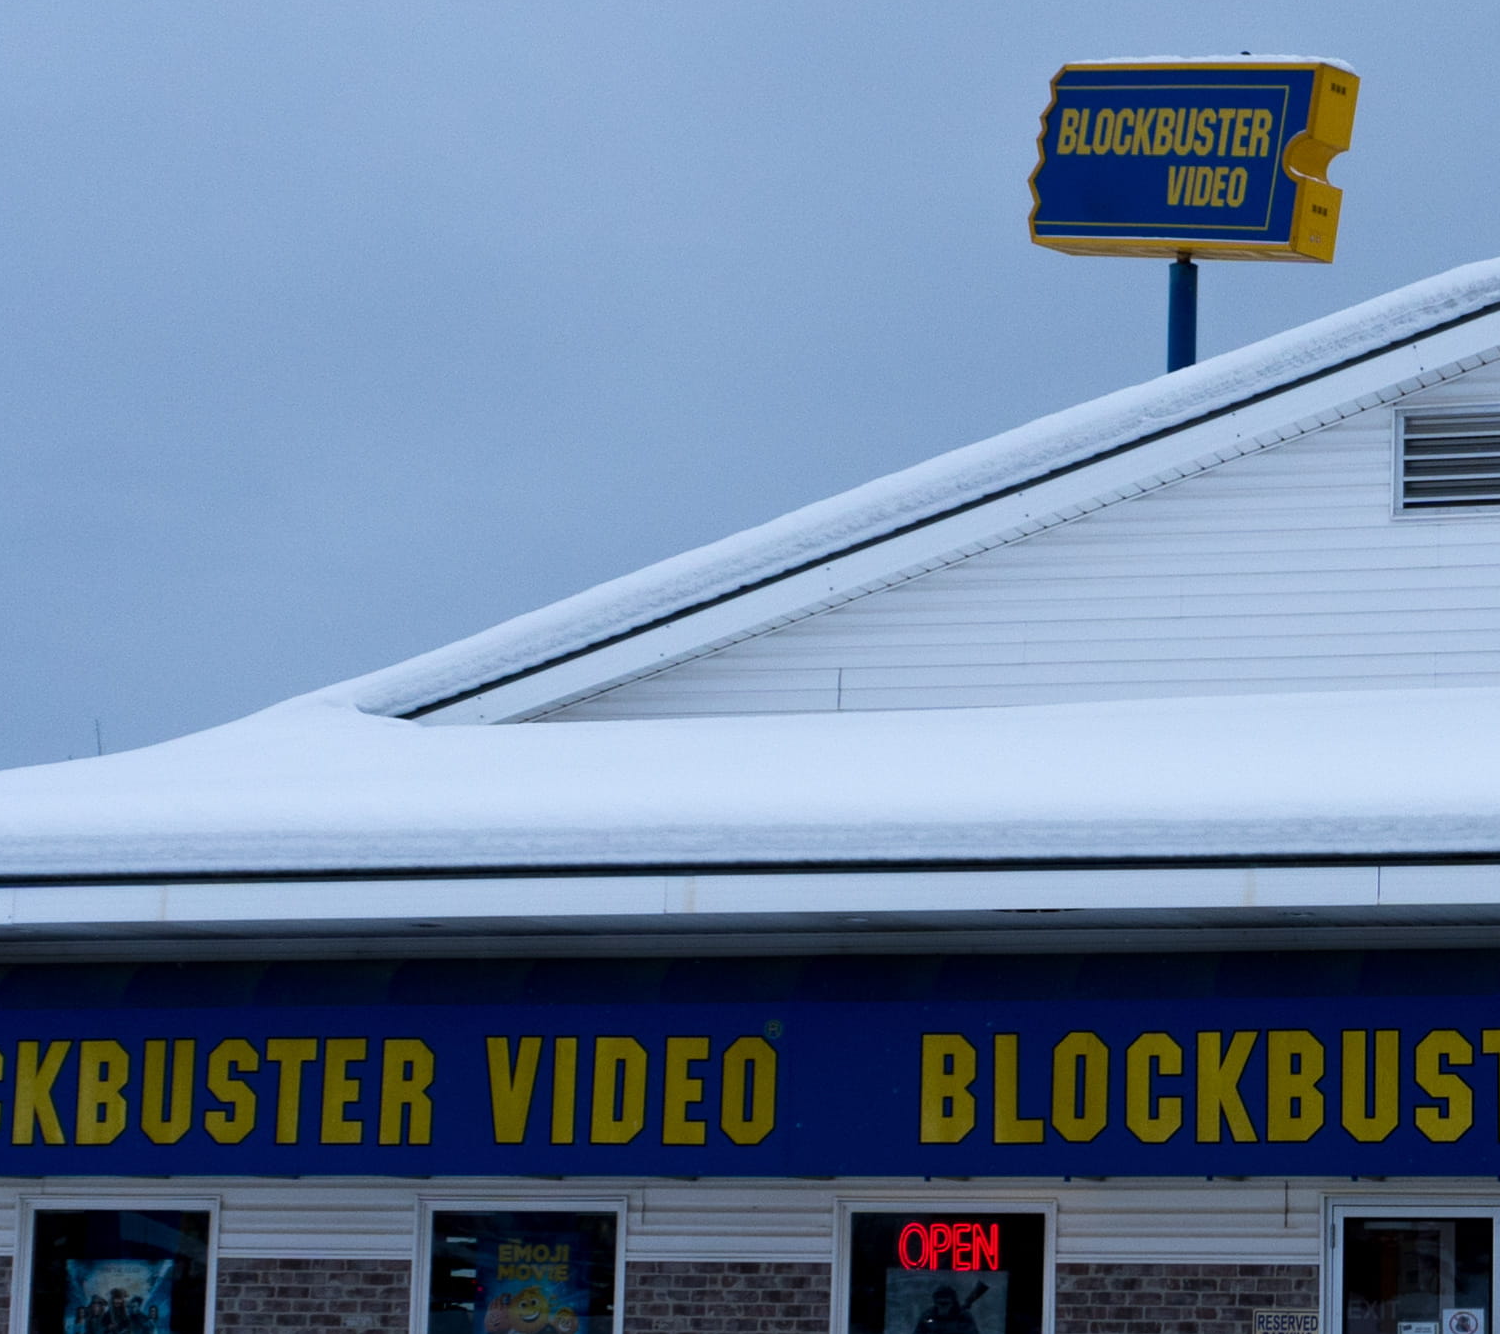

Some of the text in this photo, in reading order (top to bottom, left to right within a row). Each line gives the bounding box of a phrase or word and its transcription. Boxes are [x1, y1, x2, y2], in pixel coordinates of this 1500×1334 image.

[1056, 108, 1273, 157] BLOCKBUSTER
[1167, 166, 1248, 208] VIDEO
[484, 1034, 779, 1147] VIDEO
[498, 1243, 571, 1264] EMOJI
[898, 1221, 1000, 1271] OPEN
[496, 1264, 571, 1282] MOVIE
[1257, 1315, 1319, 1331] RESERVED
